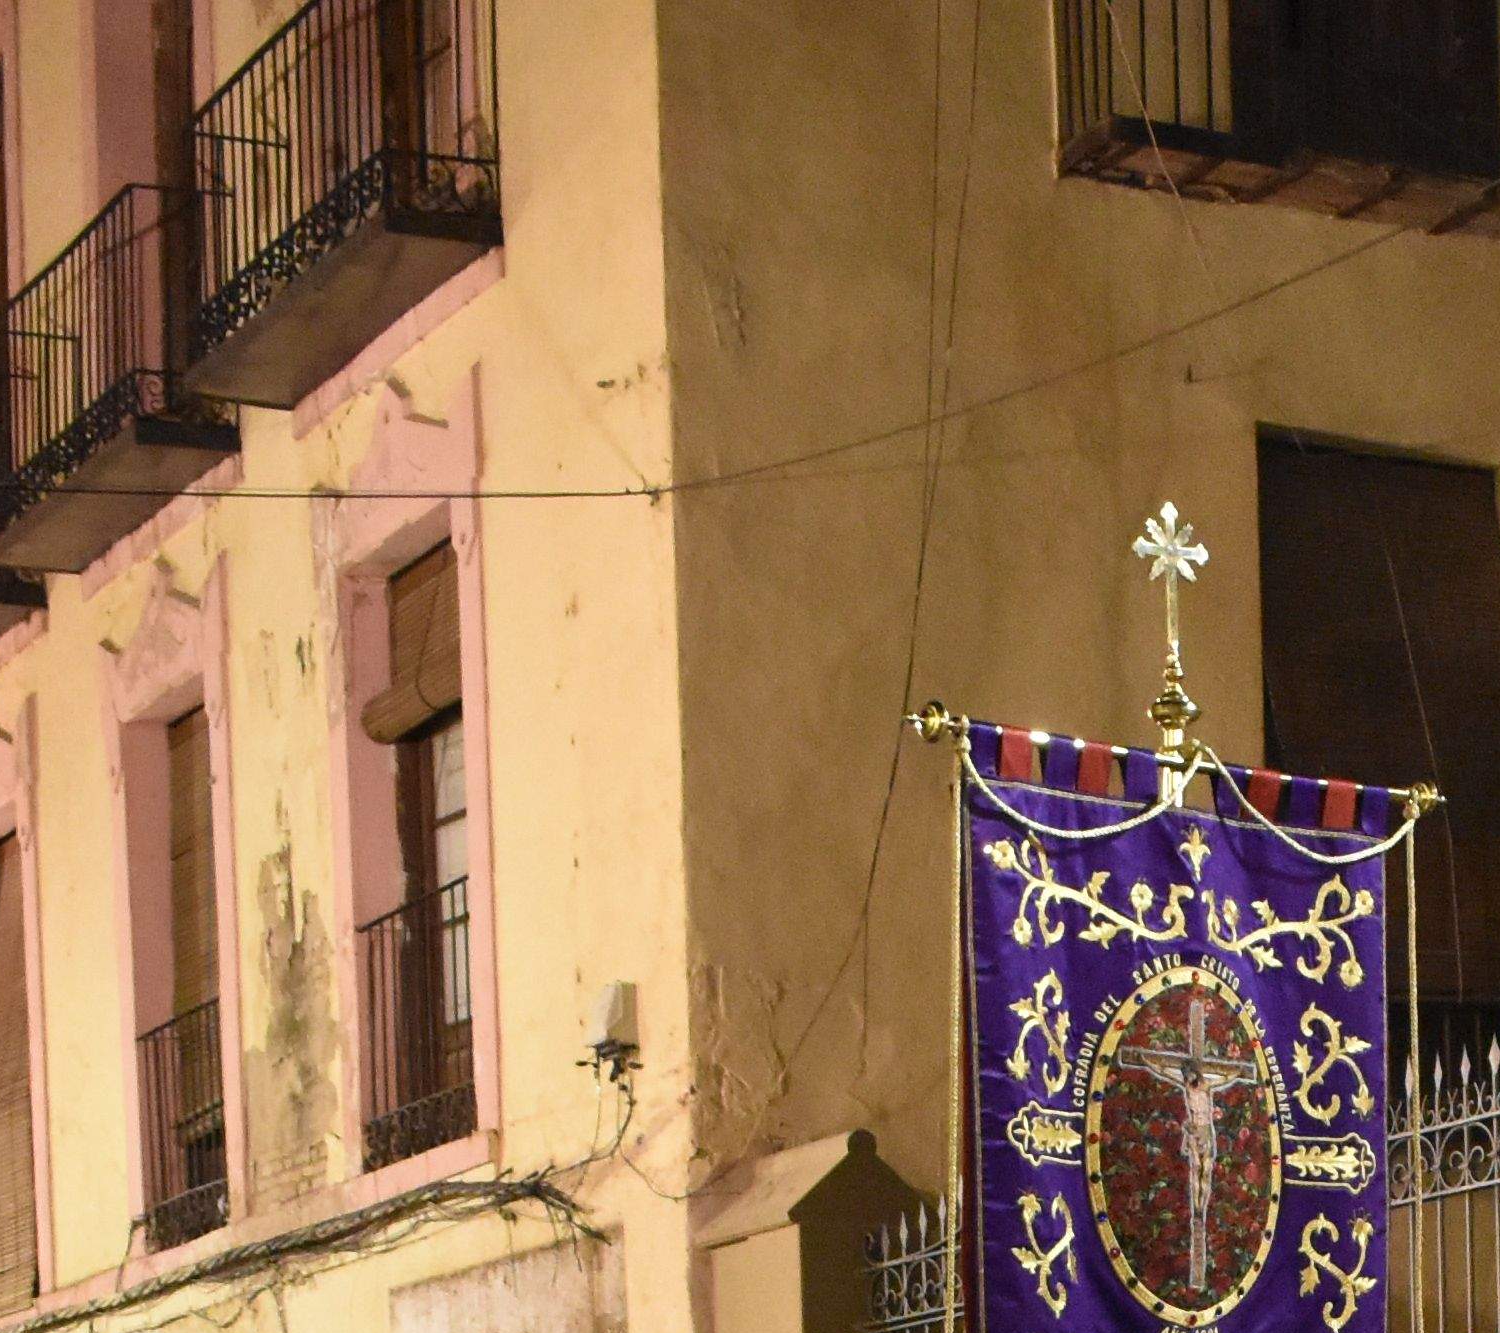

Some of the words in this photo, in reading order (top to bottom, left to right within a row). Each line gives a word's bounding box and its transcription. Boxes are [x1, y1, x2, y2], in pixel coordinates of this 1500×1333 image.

[1072, 1032, 1100, 1107] COFRADIA
[1094, 994, 1121, 1023] DEL
[1132, 953, 1181, 984] SANTO
[1200, 954, 1240, 991] CRISTO
